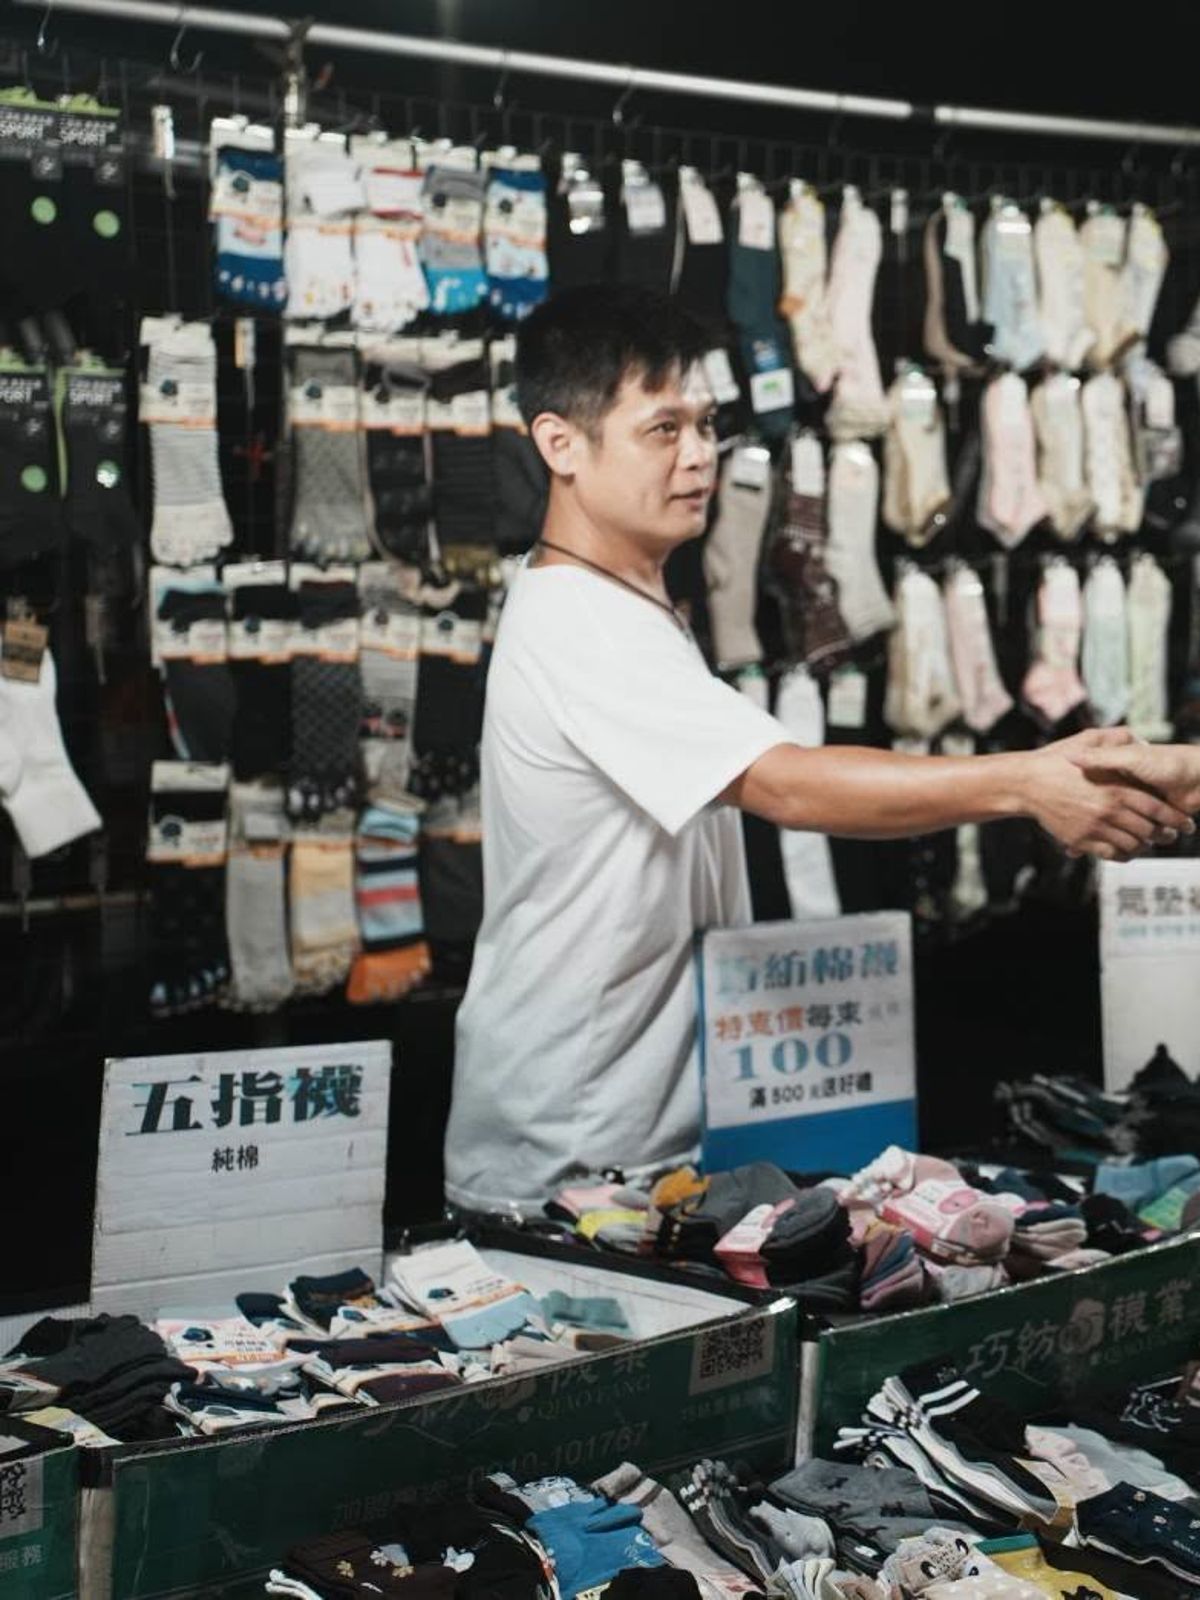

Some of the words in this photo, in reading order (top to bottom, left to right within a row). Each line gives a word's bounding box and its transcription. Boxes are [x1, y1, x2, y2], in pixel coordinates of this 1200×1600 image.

[734, 1032, 853, 1080] 100
[125, 1064, 363, 1137] 五指襪
[211, 1145, 260, 1173] 純棉
